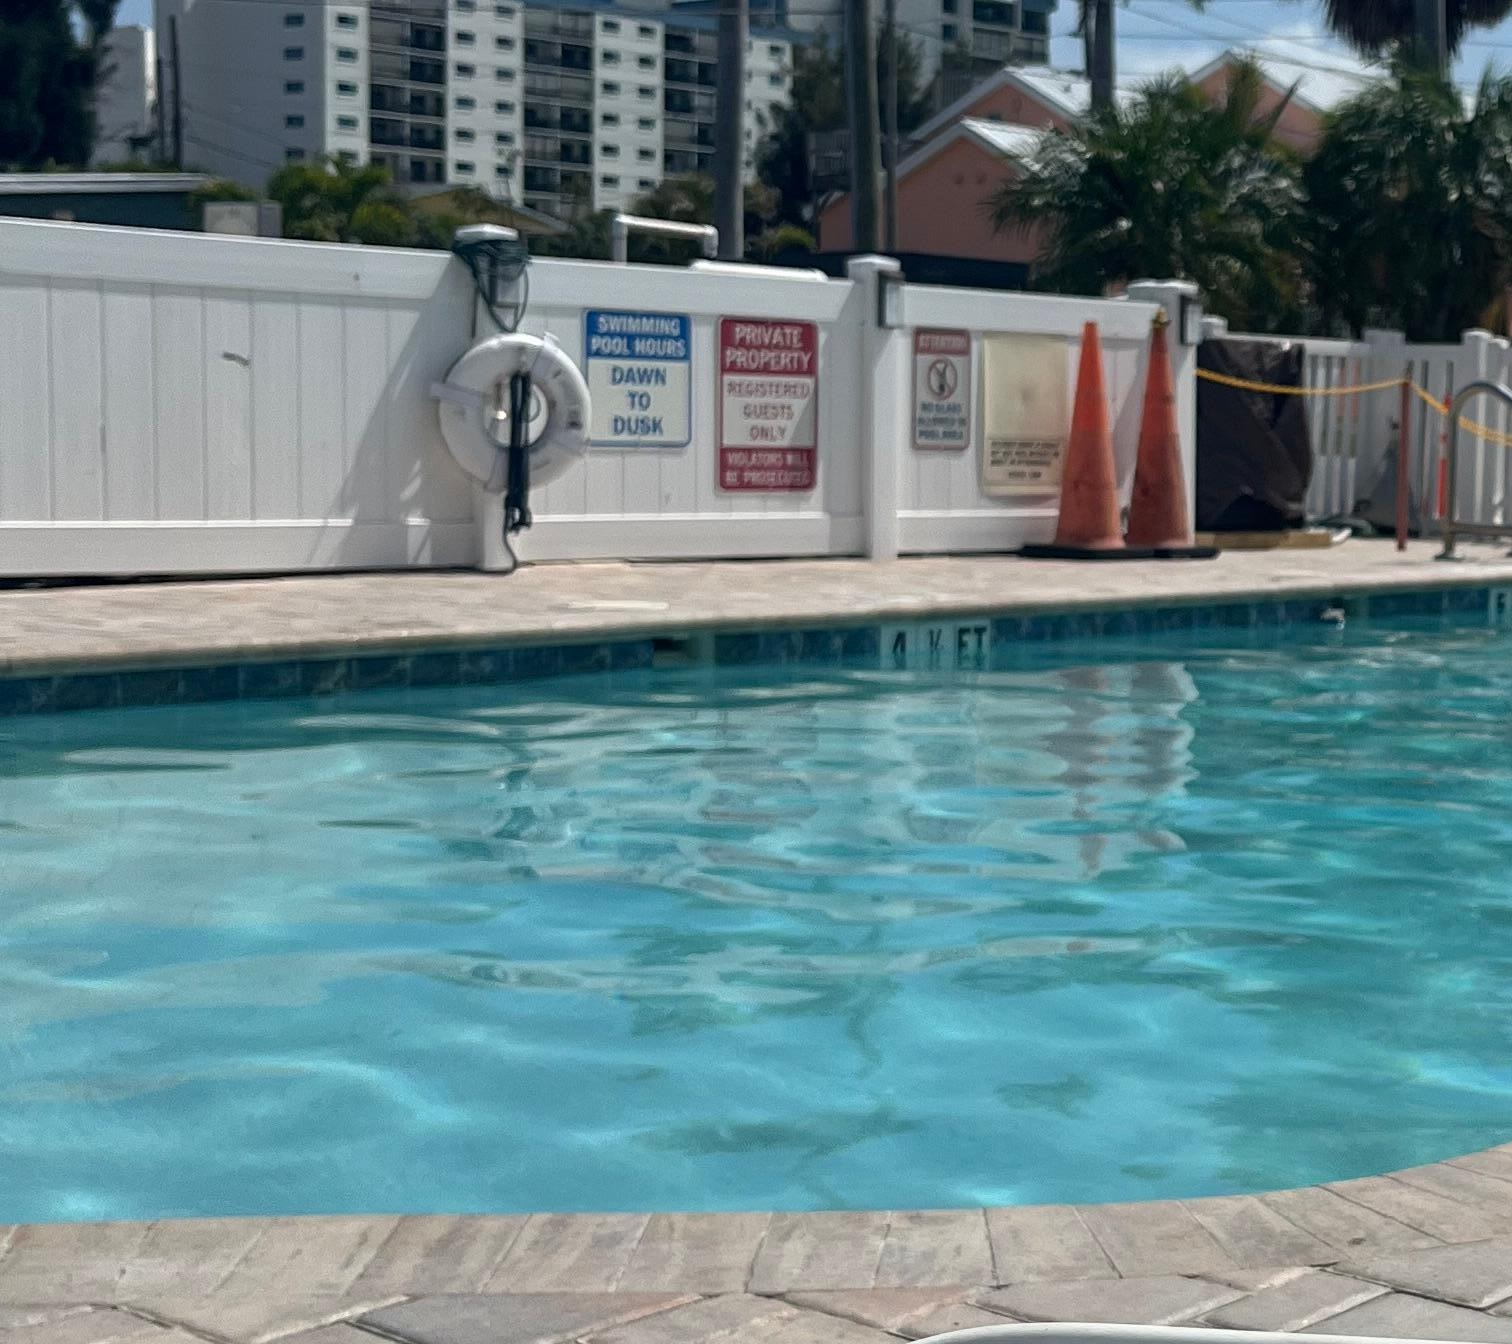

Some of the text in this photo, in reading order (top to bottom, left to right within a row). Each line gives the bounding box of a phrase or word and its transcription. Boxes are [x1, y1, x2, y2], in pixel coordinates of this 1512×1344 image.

[598, 314, 680, 336] SWIMMING
[735, 324, 803, 347] PRIVATE
[591, 335, 686, 357] POOL HOURS
[725, 347, 813, 371] PROPERTY
[611, 365, 667, 386] DAWN
[626, 389, 651, 411] TO
[726, 380, 811, 400] REGISTERED
[743, 403, 795, 421] GUESTS
[612, 415, 664, 436] DUSK
[750, 424, 787, 443] ONLY
